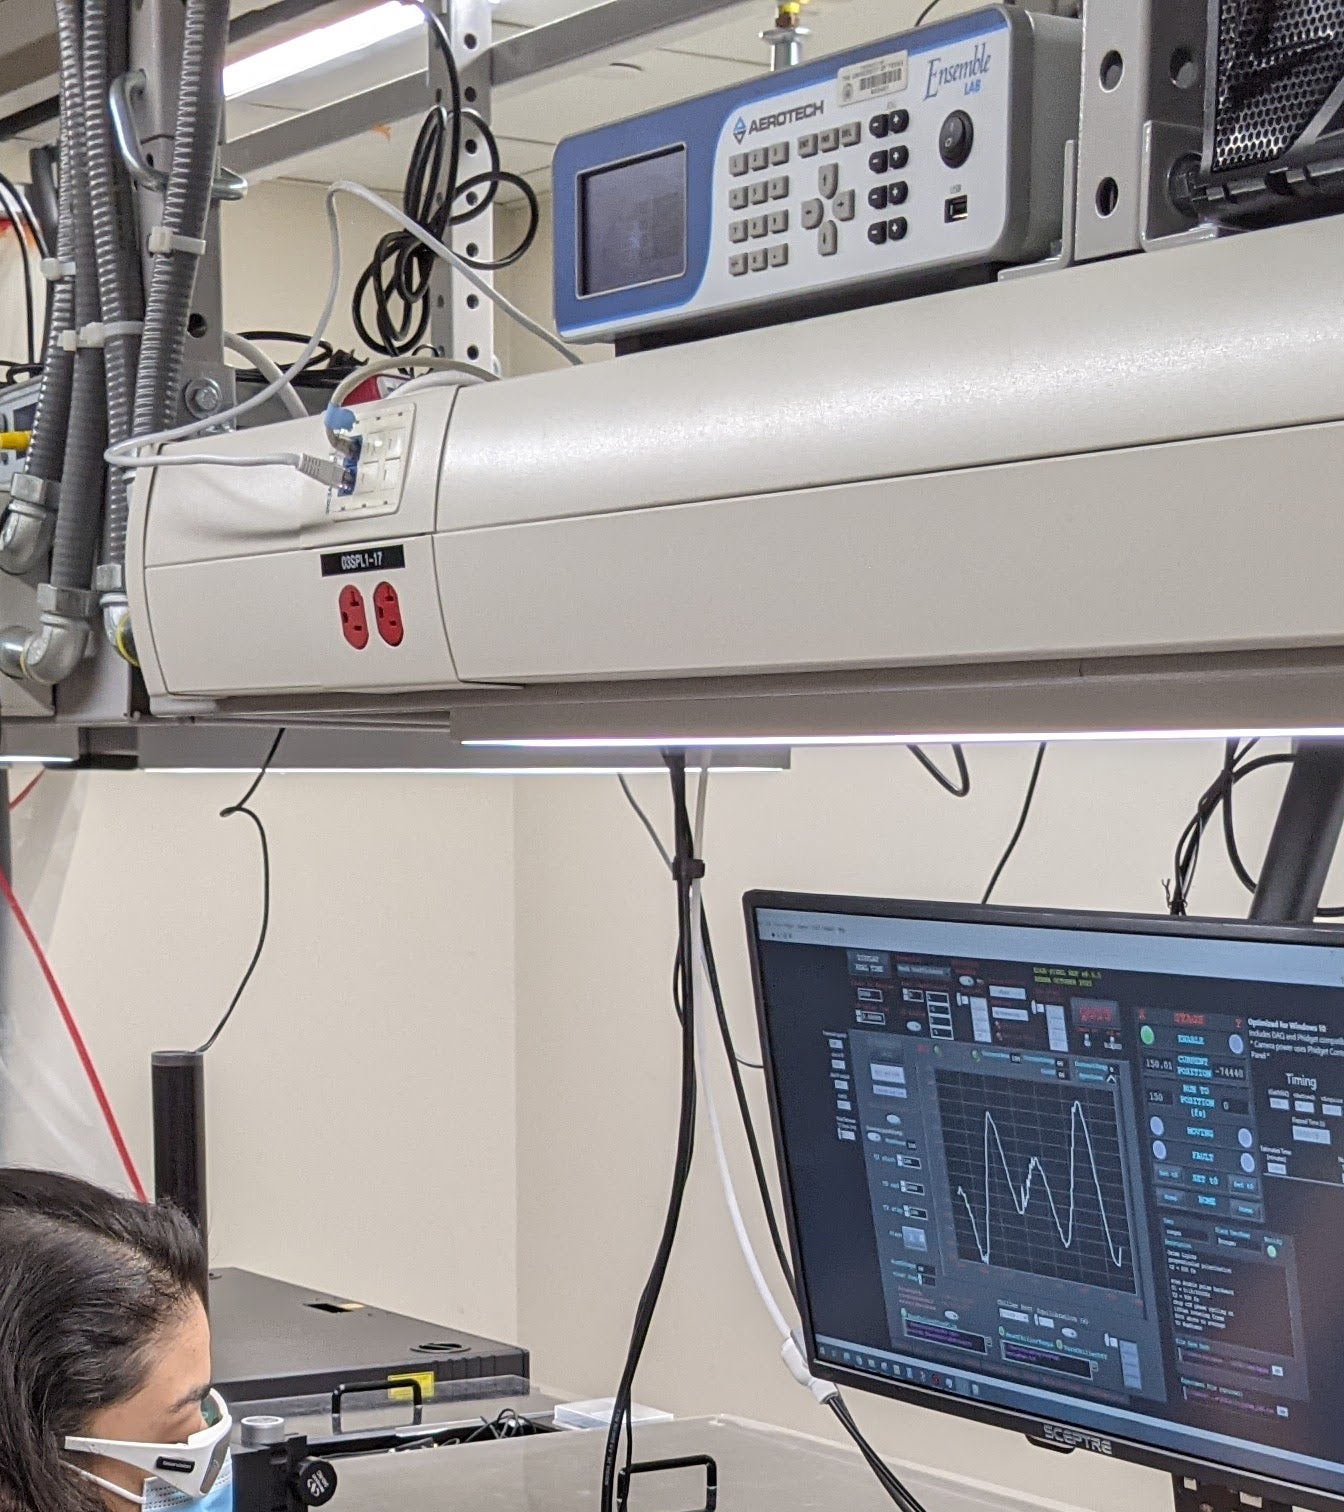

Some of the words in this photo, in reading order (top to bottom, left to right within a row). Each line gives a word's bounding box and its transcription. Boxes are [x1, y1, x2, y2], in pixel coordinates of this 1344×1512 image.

[923, 42, 992, 101] Ensemble
[964, 79, 981, 95] LAB
[749, 100, 824, 135] AEROTECH
[1248, 1018, 1278, 1028] Optimized
[1289, 1022, 1318, 1032] Windows
[1286, 1073, 1317, 1091] Timing
[1043, 1424, 1113, 1456] SCEPTRE
